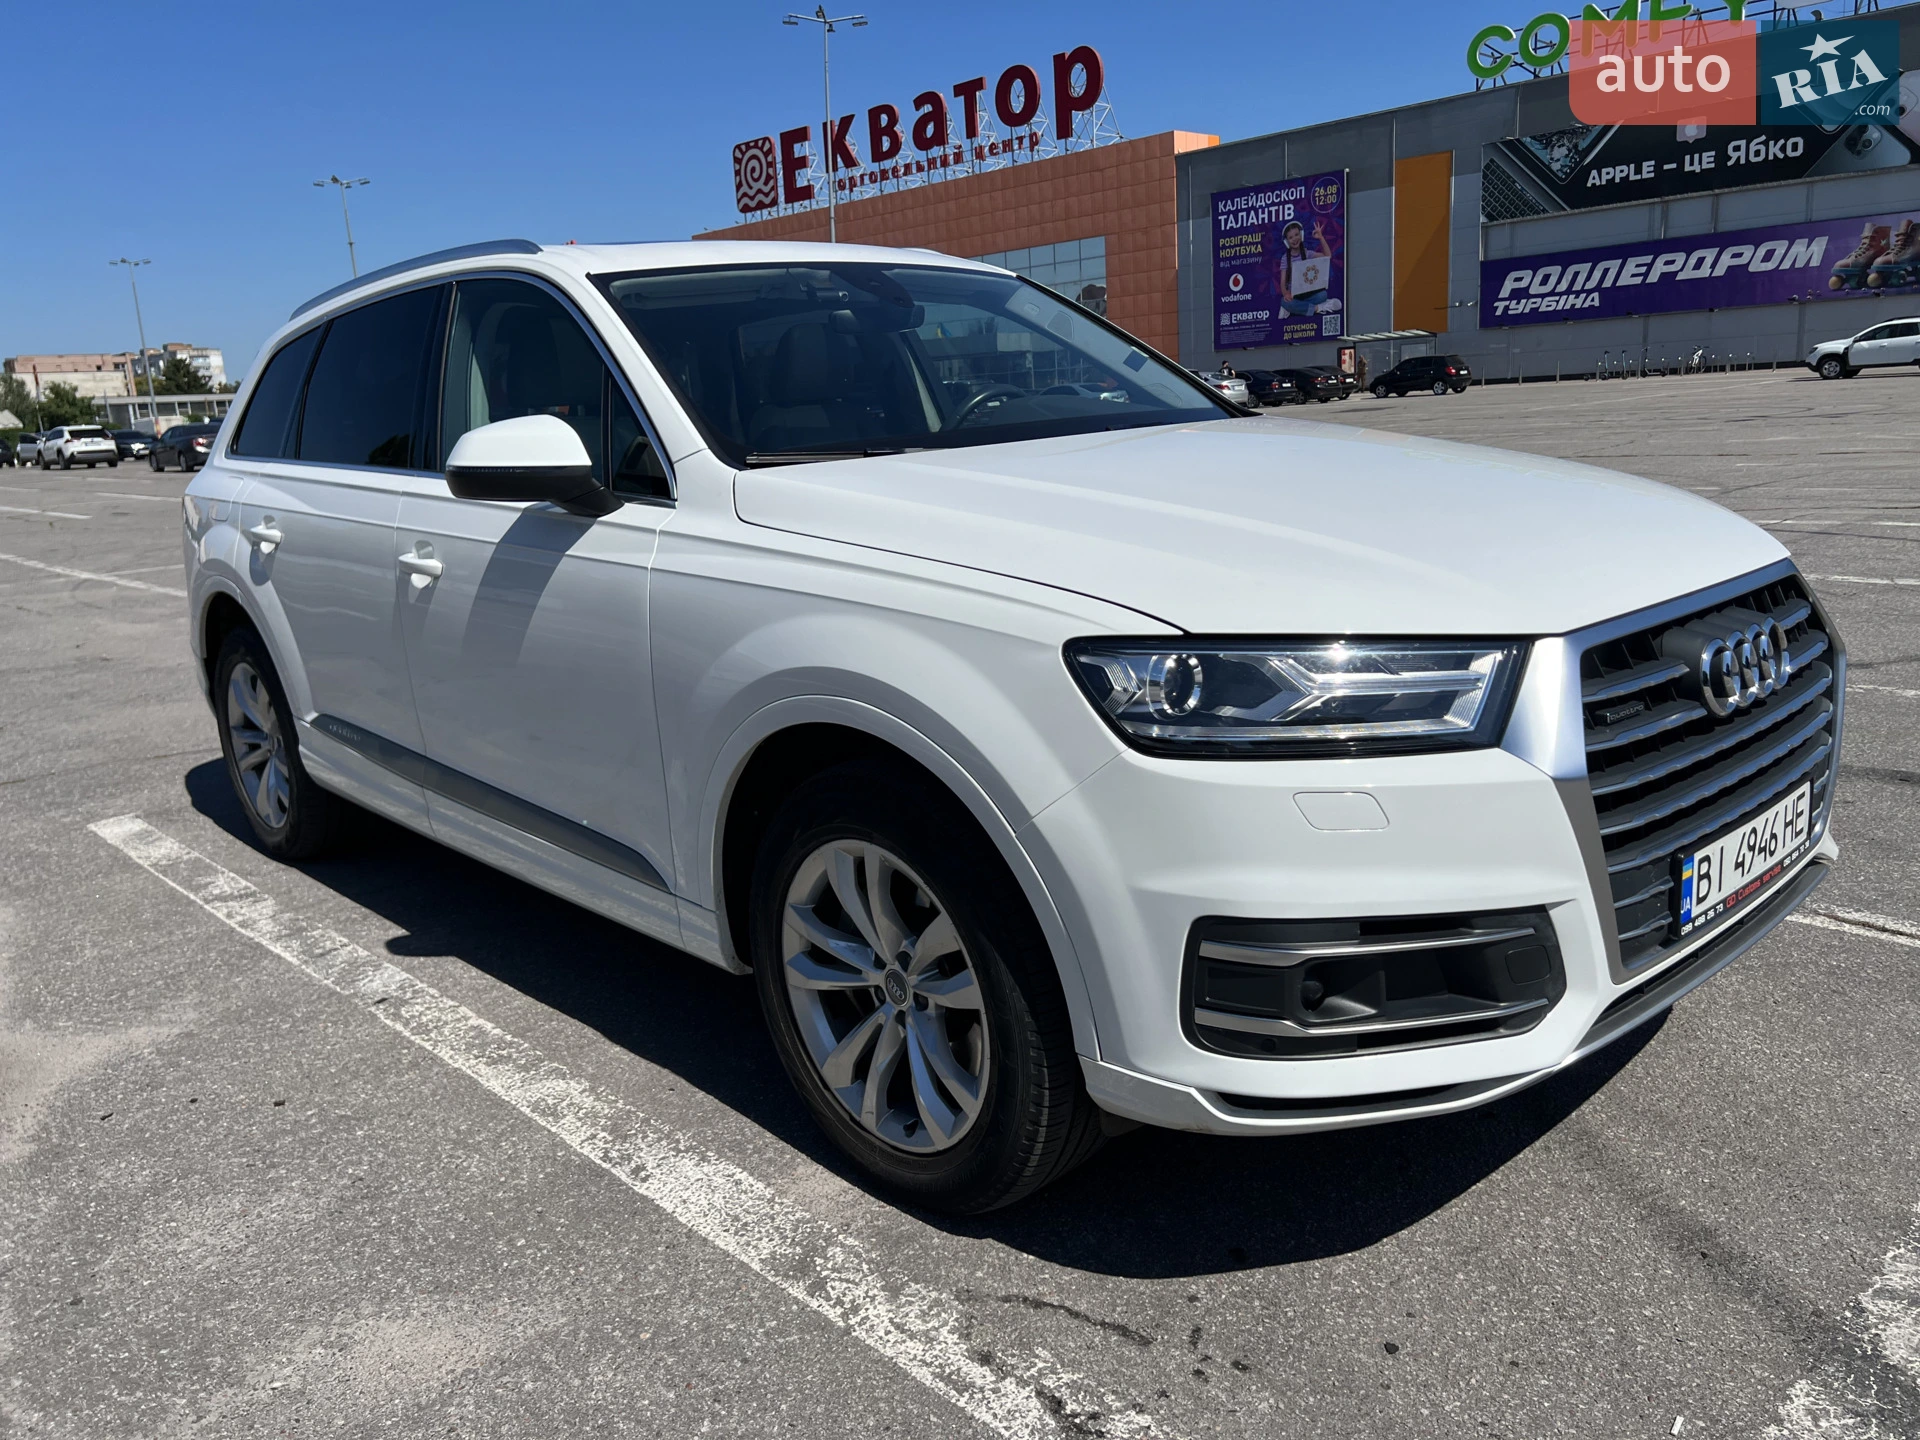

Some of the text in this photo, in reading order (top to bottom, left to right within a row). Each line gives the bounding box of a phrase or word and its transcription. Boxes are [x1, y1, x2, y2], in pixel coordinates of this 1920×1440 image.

[829, 131, 1040, 193] орговельний центр
[1586, 160, 1656, 188] APPLE
[1684, 150, 1716, 173] ЦЕ
[1218, 186, 1305, 213] КАЛЕЙДОСКОП
[1315, 184, 1338, 197] 26.08
[1315, 194, 1337, 206] 12:00
[1218, 204, 1295, 231] ТАЛАНТІВ
[1219, 244, 1263, 259] НОУТБУКА
[1231, 256, 1263, 267] магазину
[1498, 236, 1829, 298] РОЛЛЕРДРОМ
[1221, 293, 1252, 303] vodafone
[1493, 291, 1600, 316] ТУРБІНА
[1293, 330, 1315, 339] ШКОЛИ
[1696, 846, 1724, 906] BI
[1733, 810, 1779, 877] 4946
[1782, 791, 1806, 849] HE
